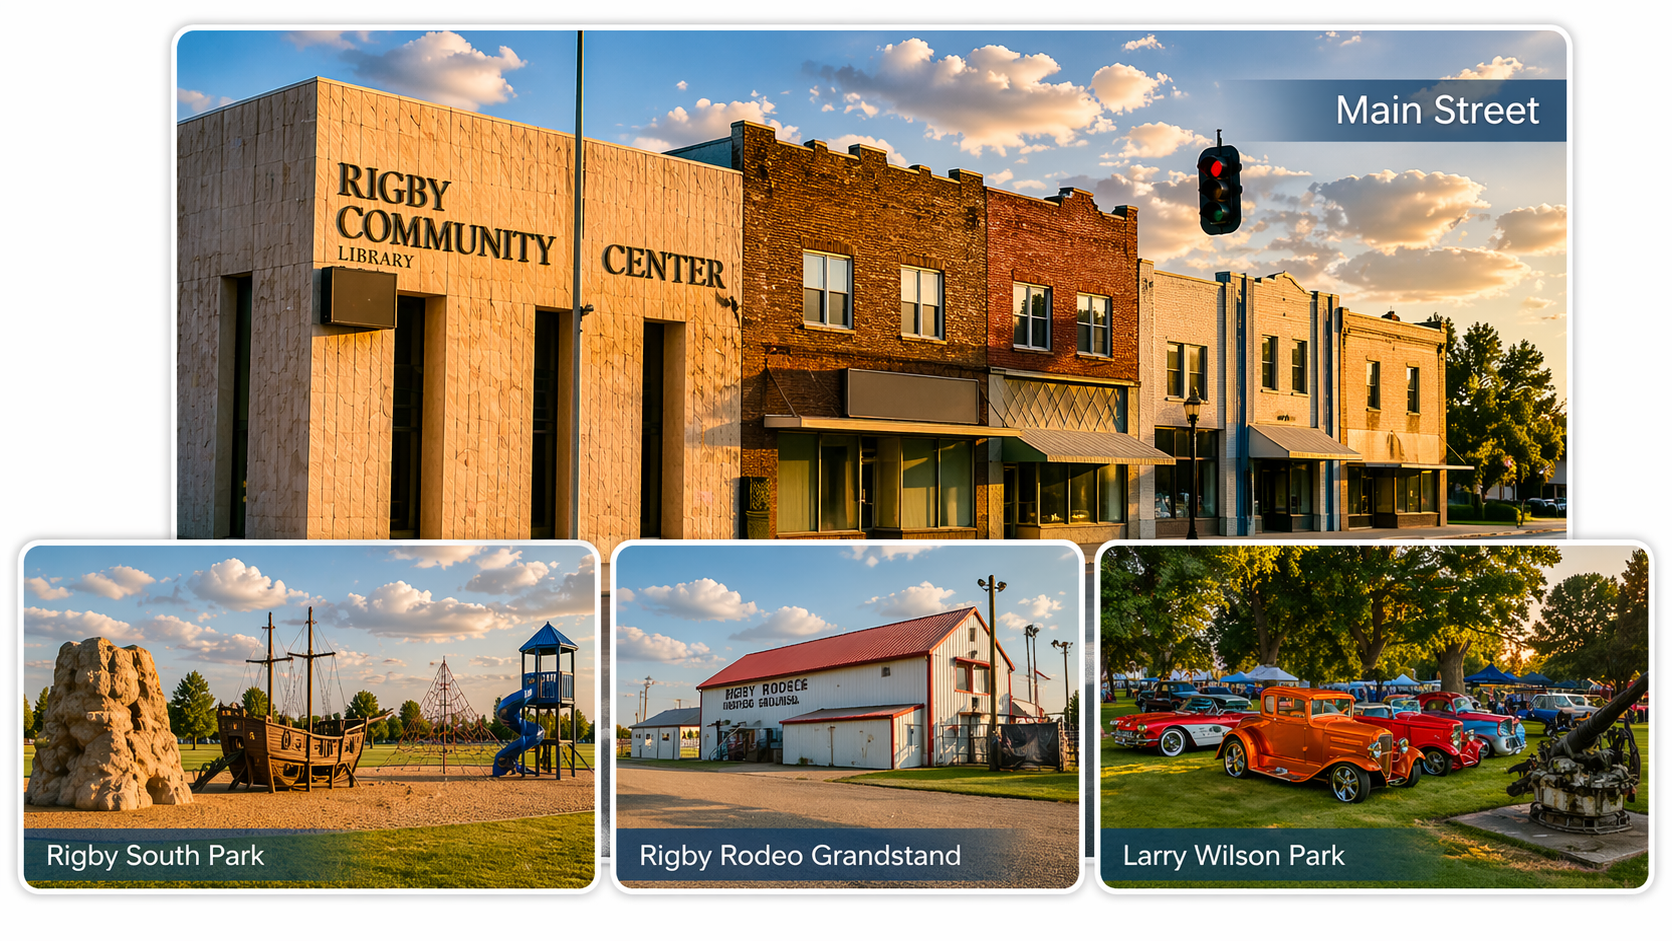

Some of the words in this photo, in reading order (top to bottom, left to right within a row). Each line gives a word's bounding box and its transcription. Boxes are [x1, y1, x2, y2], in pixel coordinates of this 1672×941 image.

[337, 162, 452, 212] RIGBY
[336, 205, 556, 266] COMMUNITY
[601, 243, 727, 290] CENTER
[338, 245, 415, 269] LIBRARY
